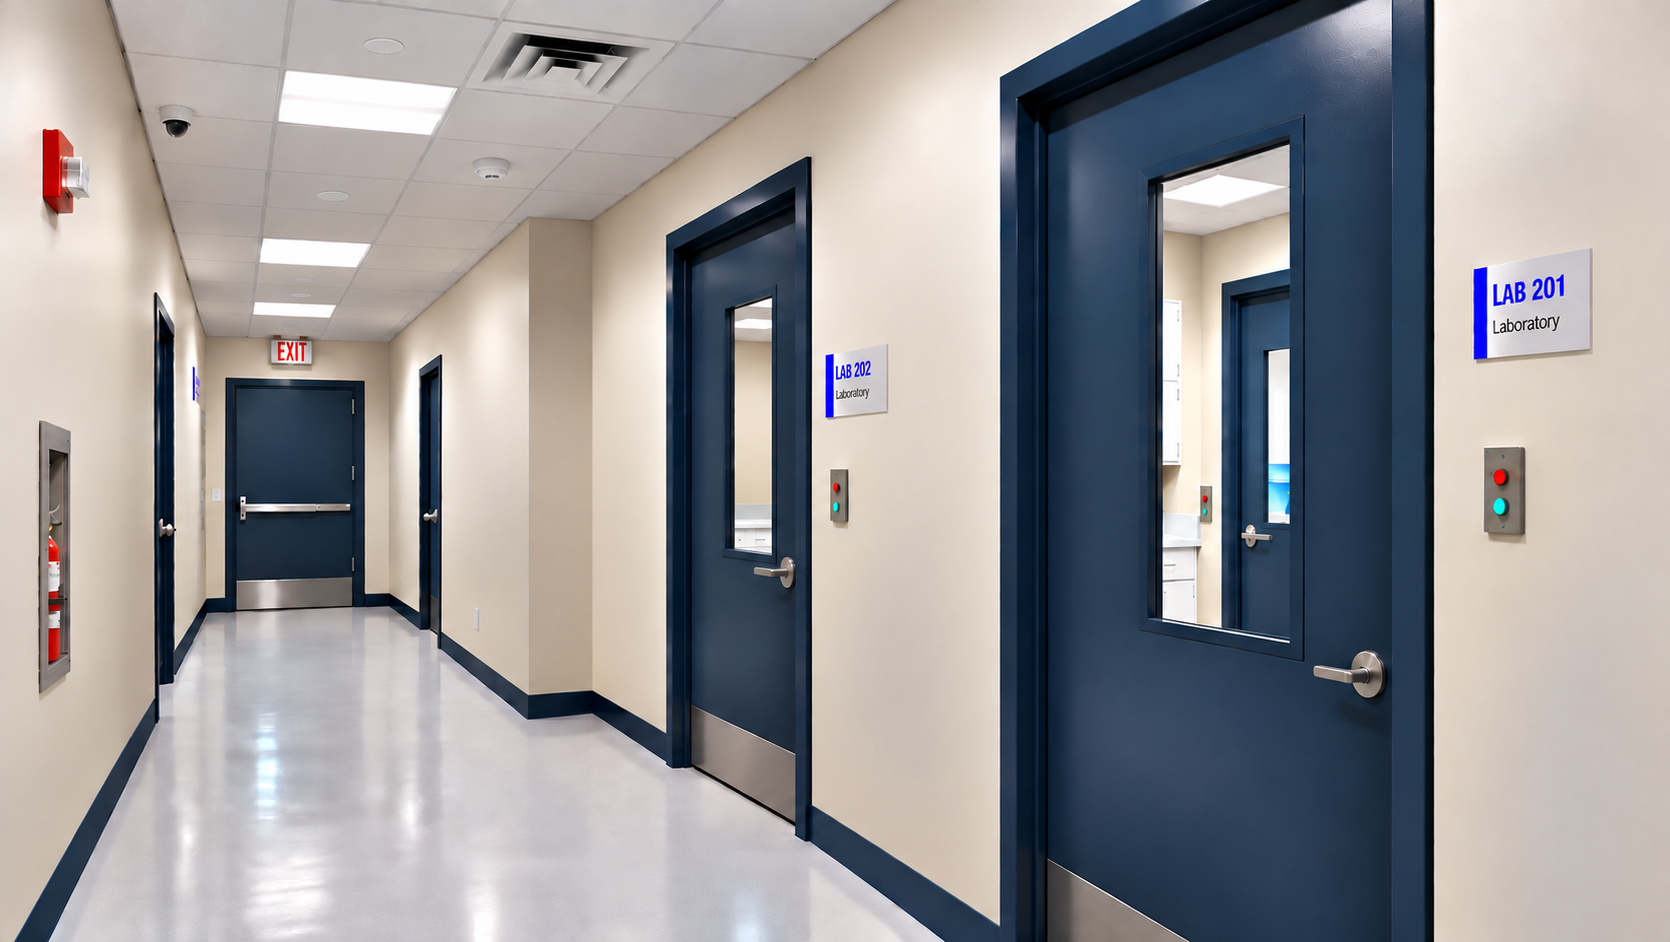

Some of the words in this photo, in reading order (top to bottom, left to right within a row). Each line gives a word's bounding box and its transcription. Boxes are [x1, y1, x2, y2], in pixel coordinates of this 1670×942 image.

[1493, 281, 1526, 306] LAB
[1532, 274, 1564, 301] 201
[1493, 316, 1560, 334] Laboratory
[277, 341, 307, 362] EXIT
[836, 363, 852, 380] LAB
[854, 360, 872, 378] 202
[836, 388, 870, 400] Laboratory
